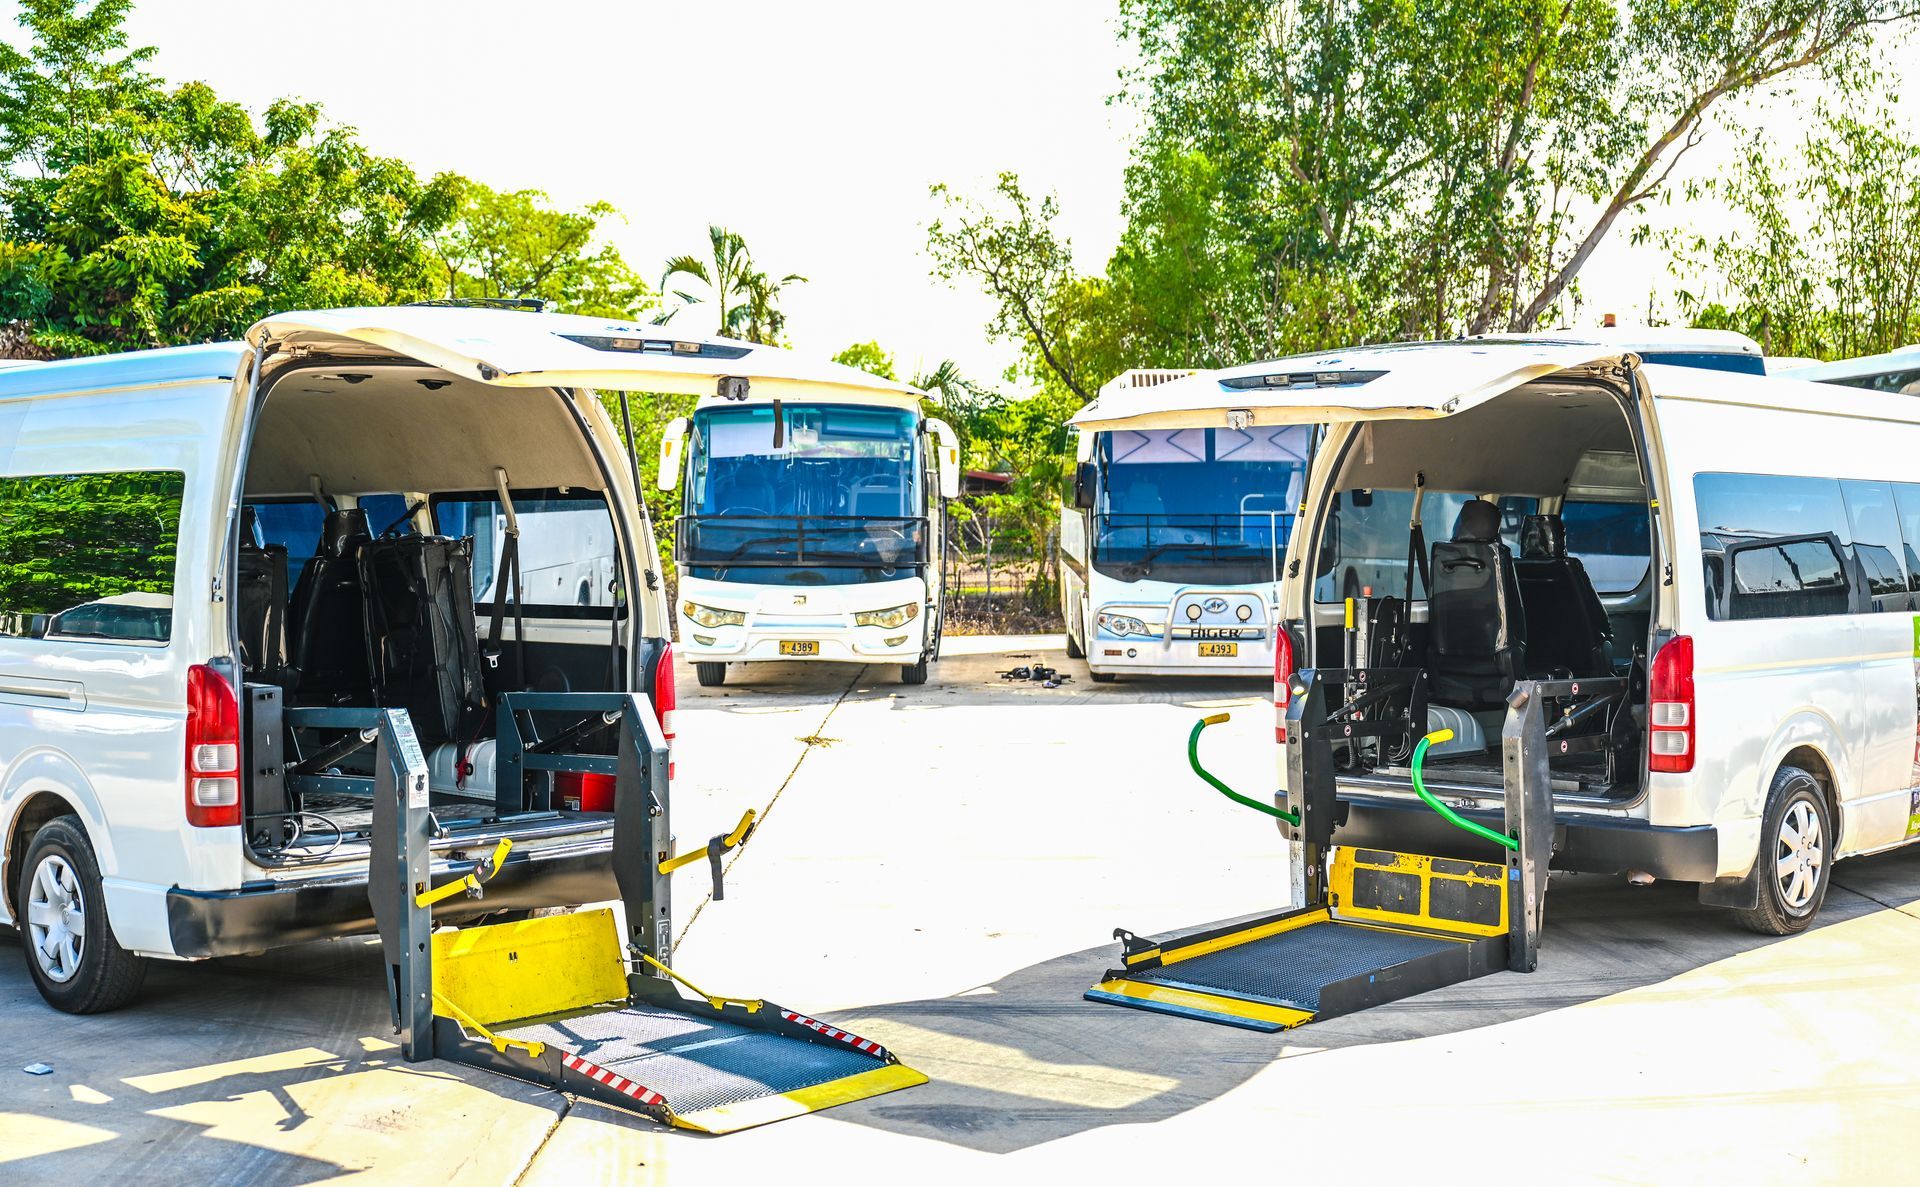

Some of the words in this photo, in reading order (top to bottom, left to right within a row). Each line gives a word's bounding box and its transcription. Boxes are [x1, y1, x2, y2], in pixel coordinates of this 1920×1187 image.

[1190, 628, 1240, 638] HIGER
[791, 642, 813, 652] 4389
[1210, 644, 1232, 654] 4393
